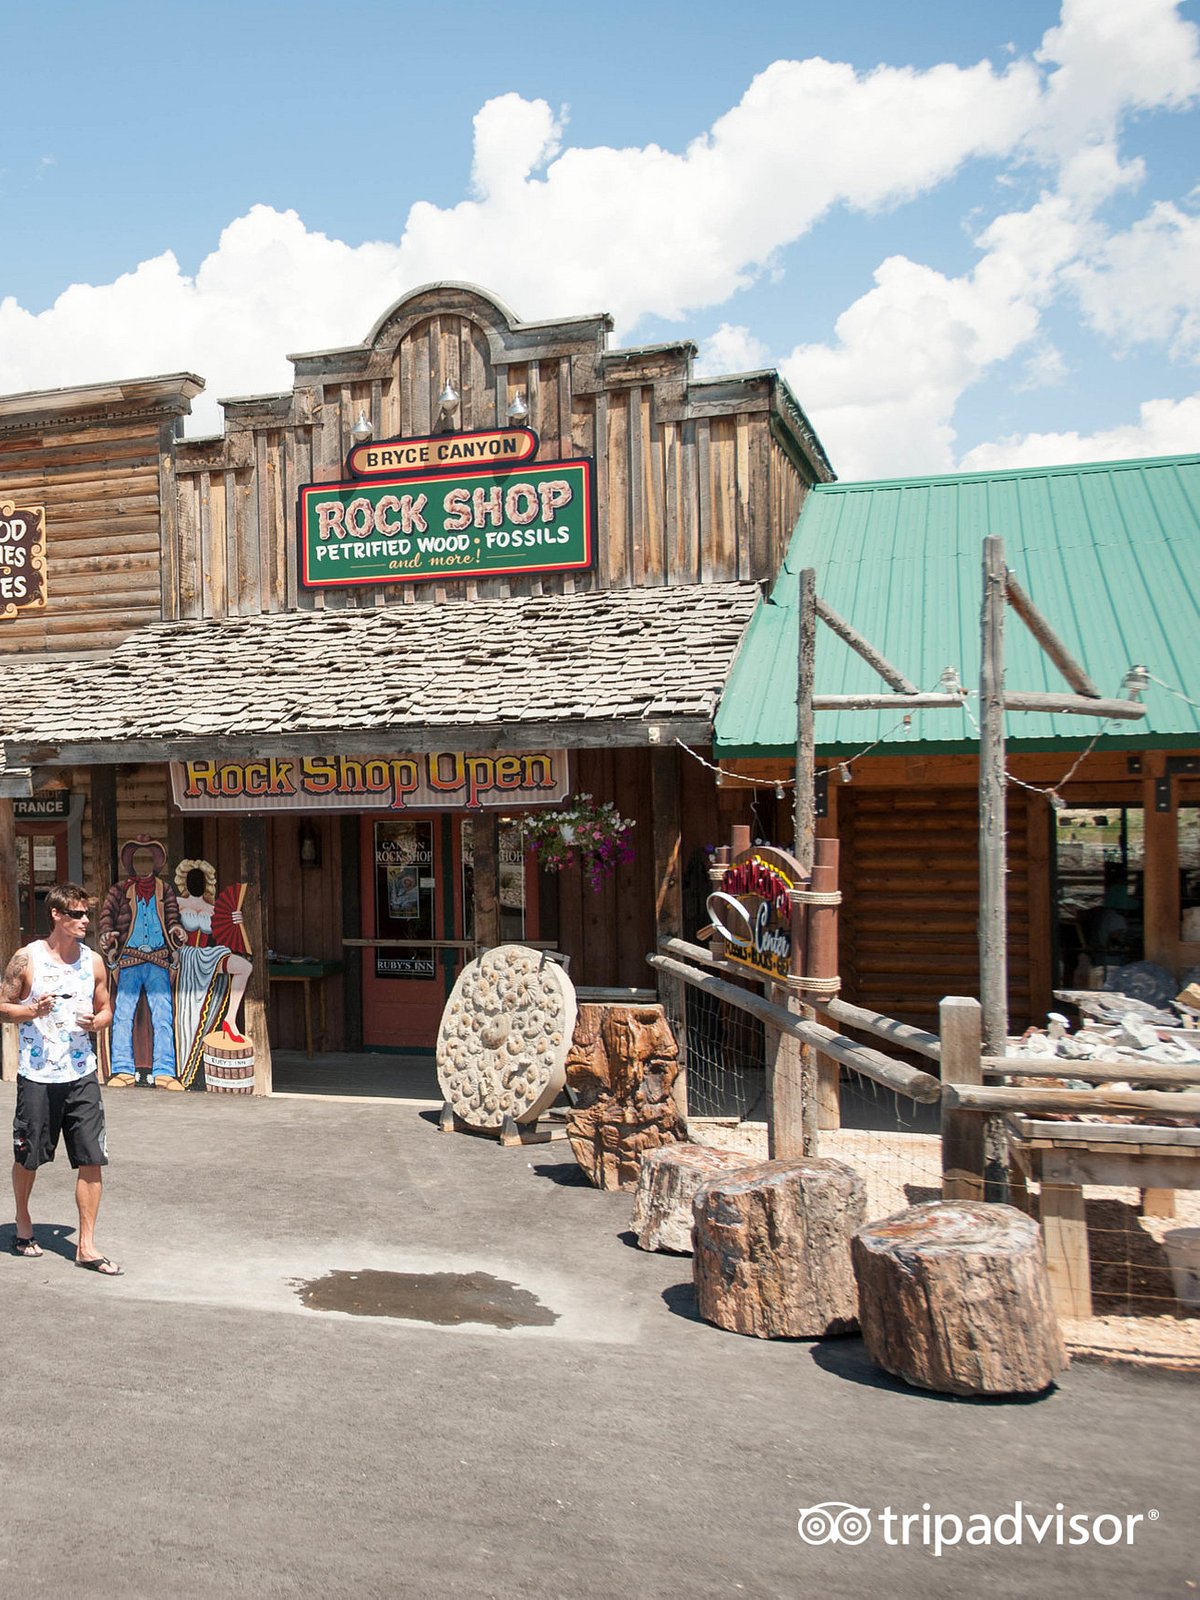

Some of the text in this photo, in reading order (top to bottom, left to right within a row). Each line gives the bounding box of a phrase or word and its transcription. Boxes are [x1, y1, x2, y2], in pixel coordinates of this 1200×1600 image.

[367, 438, 517, 467] BRYCE CANYON
[315, 480, 573, 540] ROCK SHOP
[315, 526, 570, 561] PETRIFIED WOOD FOSSILS
[388, 548, 482, 569] and more!
[184, 751, 558, 809] Rock Shop Open
[12, 801, 64, 813] TRANCE
[376, 850, 403, 862] ROCK
[755, 901, 791, 958] Center
[377, 961, 434, 971] RUBY'S INN
